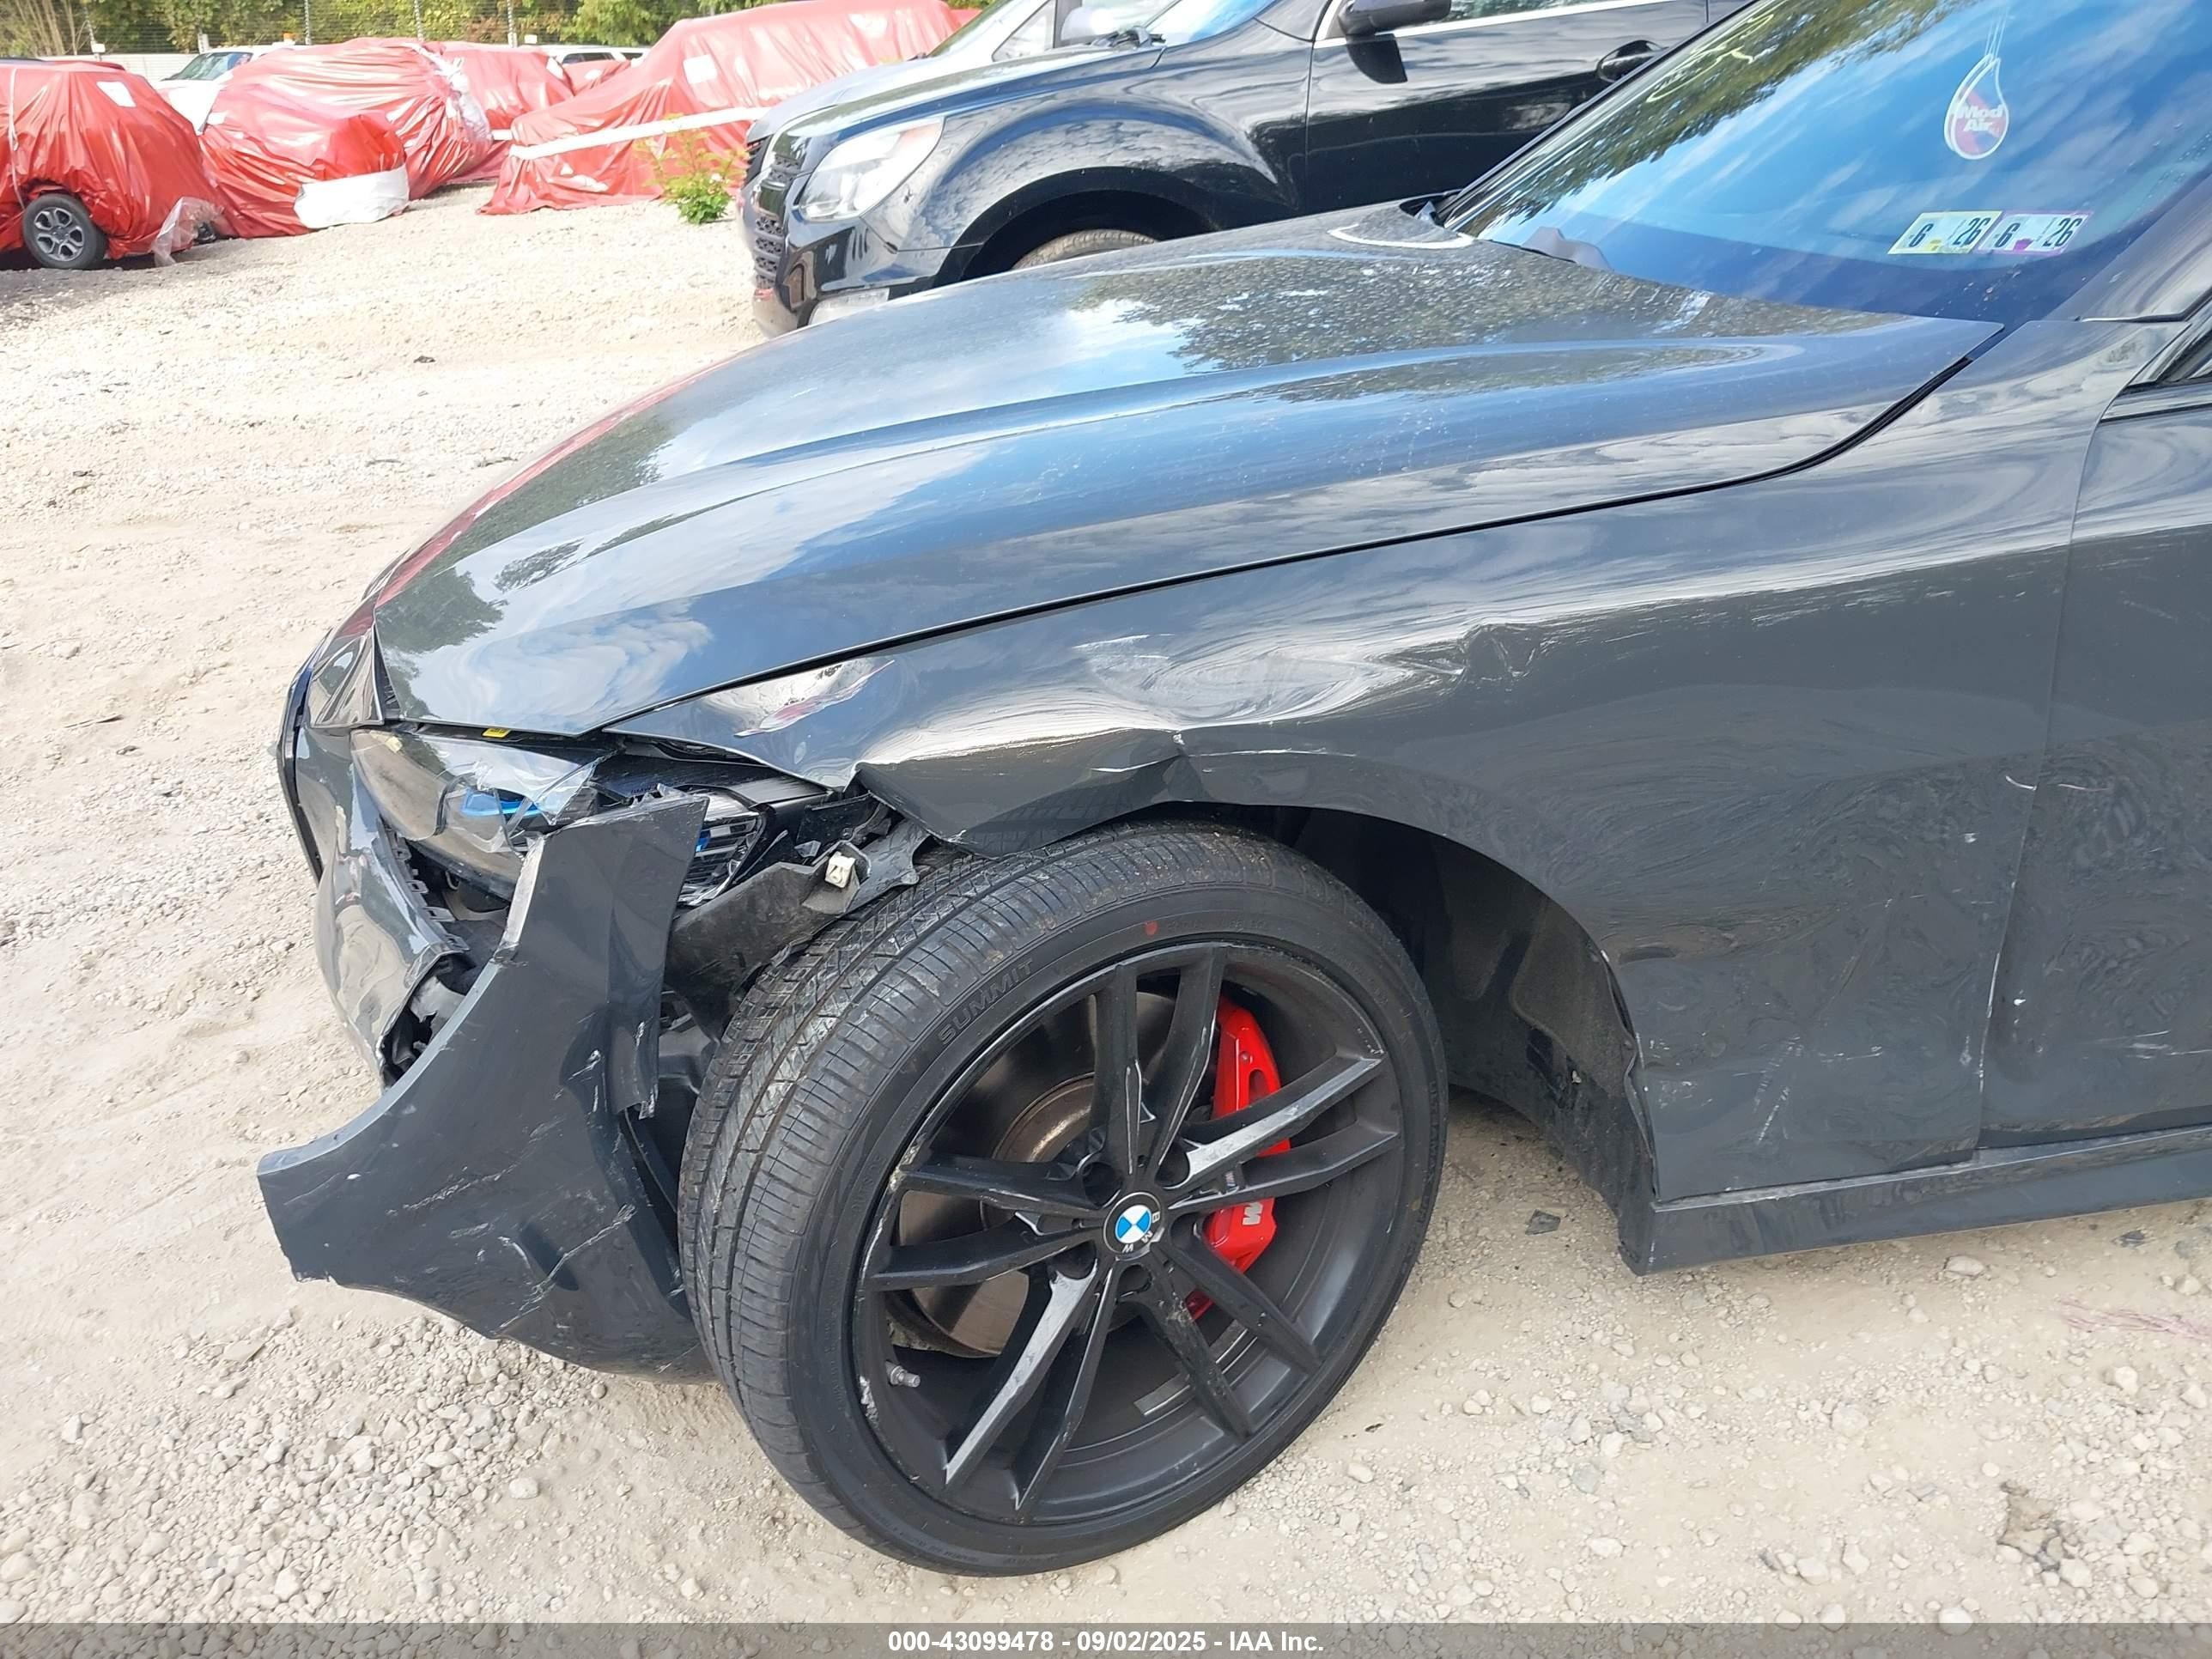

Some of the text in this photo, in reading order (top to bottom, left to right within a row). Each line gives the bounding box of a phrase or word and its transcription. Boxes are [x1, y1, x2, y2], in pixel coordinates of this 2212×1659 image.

[1963, 118, 1993, 131] Air
[1909, 217, 1991, 247] 6 26
[1995, 217, 2081, 247] 6 26
[938, 958, 1033, 1044] SUMMIT
